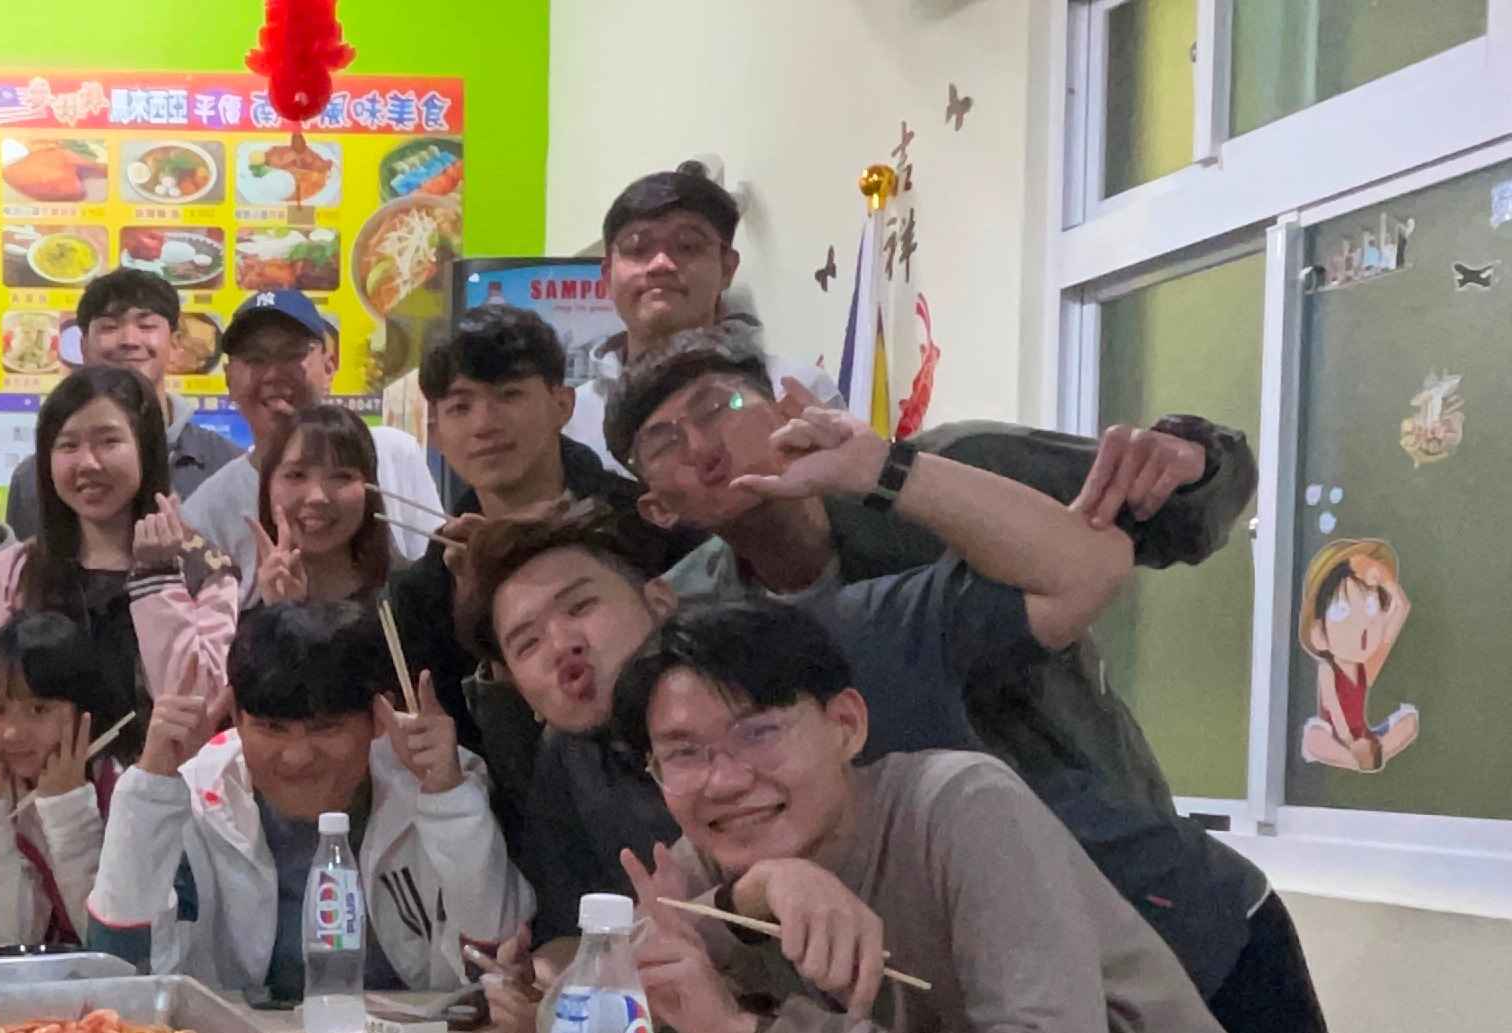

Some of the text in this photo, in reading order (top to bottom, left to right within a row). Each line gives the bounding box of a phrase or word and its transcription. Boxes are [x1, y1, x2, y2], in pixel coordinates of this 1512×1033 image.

[249, 90, 452, 131] 南風味美食
[530, 279, 608, 300] SAMPO
